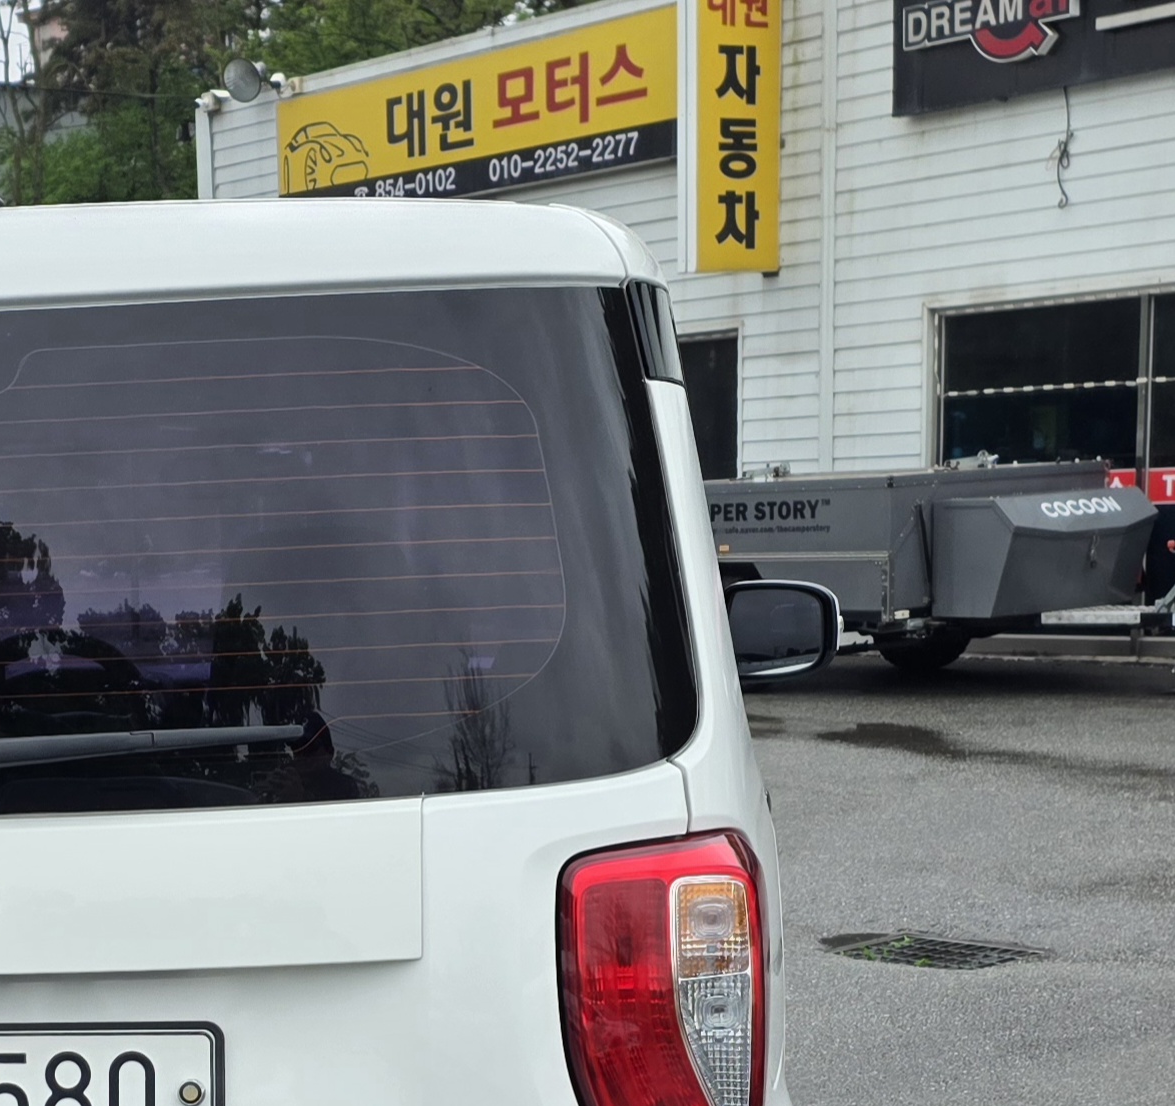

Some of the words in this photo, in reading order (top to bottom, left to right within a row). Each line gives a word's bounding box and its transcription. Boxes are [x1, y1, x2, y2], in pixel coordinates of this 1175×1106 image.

[386, 78, 475, 158] 대원
[492, 43, 648, 125] 모터스
[375, 167, 456, 197] 854-0102
[489, 131, 639, 181] 010-2252-2277
[715, 44, 760, 249] 자동차
[1041, 496, 1122, 517] COCOON
